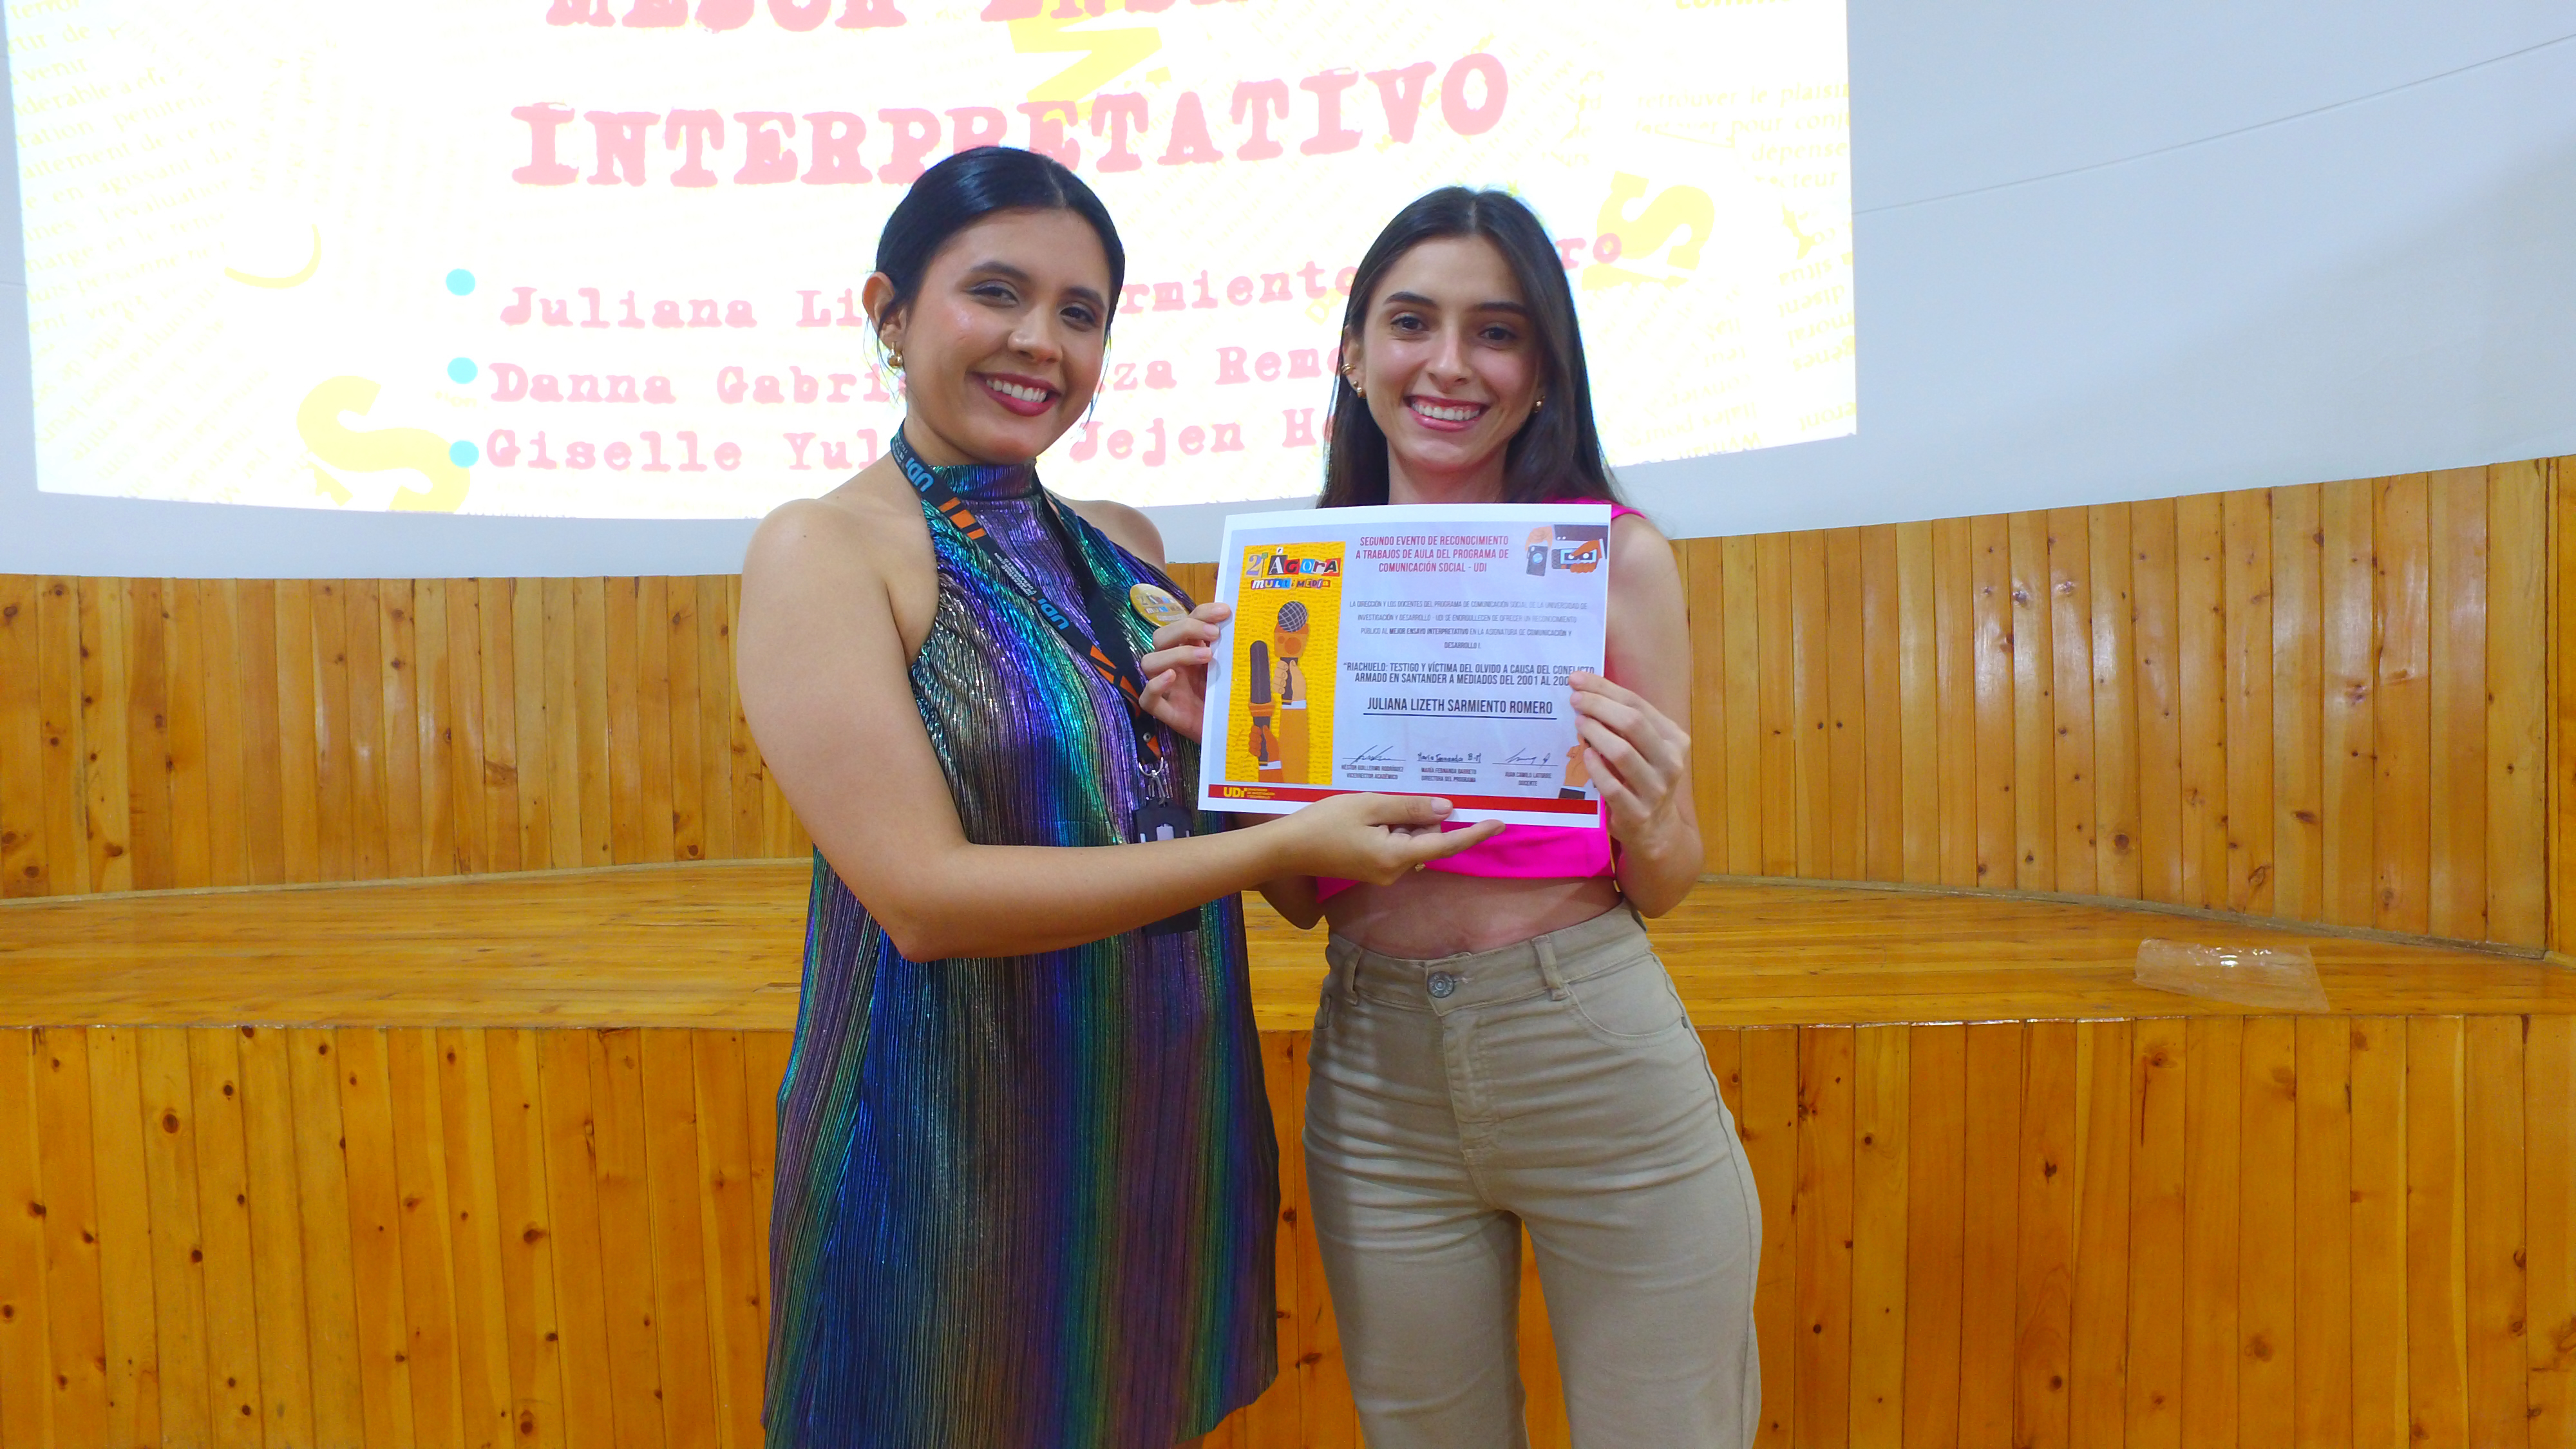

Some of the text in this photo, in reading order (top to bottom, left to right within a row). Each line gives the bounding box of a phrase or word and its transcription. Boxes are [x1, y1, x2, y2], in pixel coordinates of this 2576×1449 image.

[511, 53, 1509, 187] INTERPRETATIVO
[500, 287, 757, 328] Juliana
[1119, 261, 1358, 314] rmiento
[489, 363, 676, 404] Danna
[717, 363, 905, 404] Gabri
[487, 429, 741, 472] Giselle
[1069, 419, 1244, 466] Jejen
[1360, 535, 1509, 546] SEGUNDO EVENTO DE RECONOCIMIENTO
[1356, 549, 1509, 559] A TRABAJOS DE AULA DEL PROGRAMA DE
[1379, 561, 1436, 572] COMUNICACIÓN
[1439, 562, 1466, 572] SOCIAL
[1473, 562, 1487, 572] UDI
[1390, 663, 1419, 672] TESTIGO
[1421, 663, 1426, 672] Y
[1428, 661, 1457, 672] VÍCTIMA
[1459, 663, 1473, 673] DEL
[1475, 664, 1501, 674] OLVIDO
[1503, 664, 1508, 674] A
[1510, 665, 1535, 674] CAUSA
[1537, 665, 1550, 674] DEL
[1355, 672, 1569, 686] ARMADO EN SANTANDER A MEDIADOS DEL 2001 AL 200
[1367, 697, 1553, 714] JULIANA LIZETH SARMIENTO ROMERO
